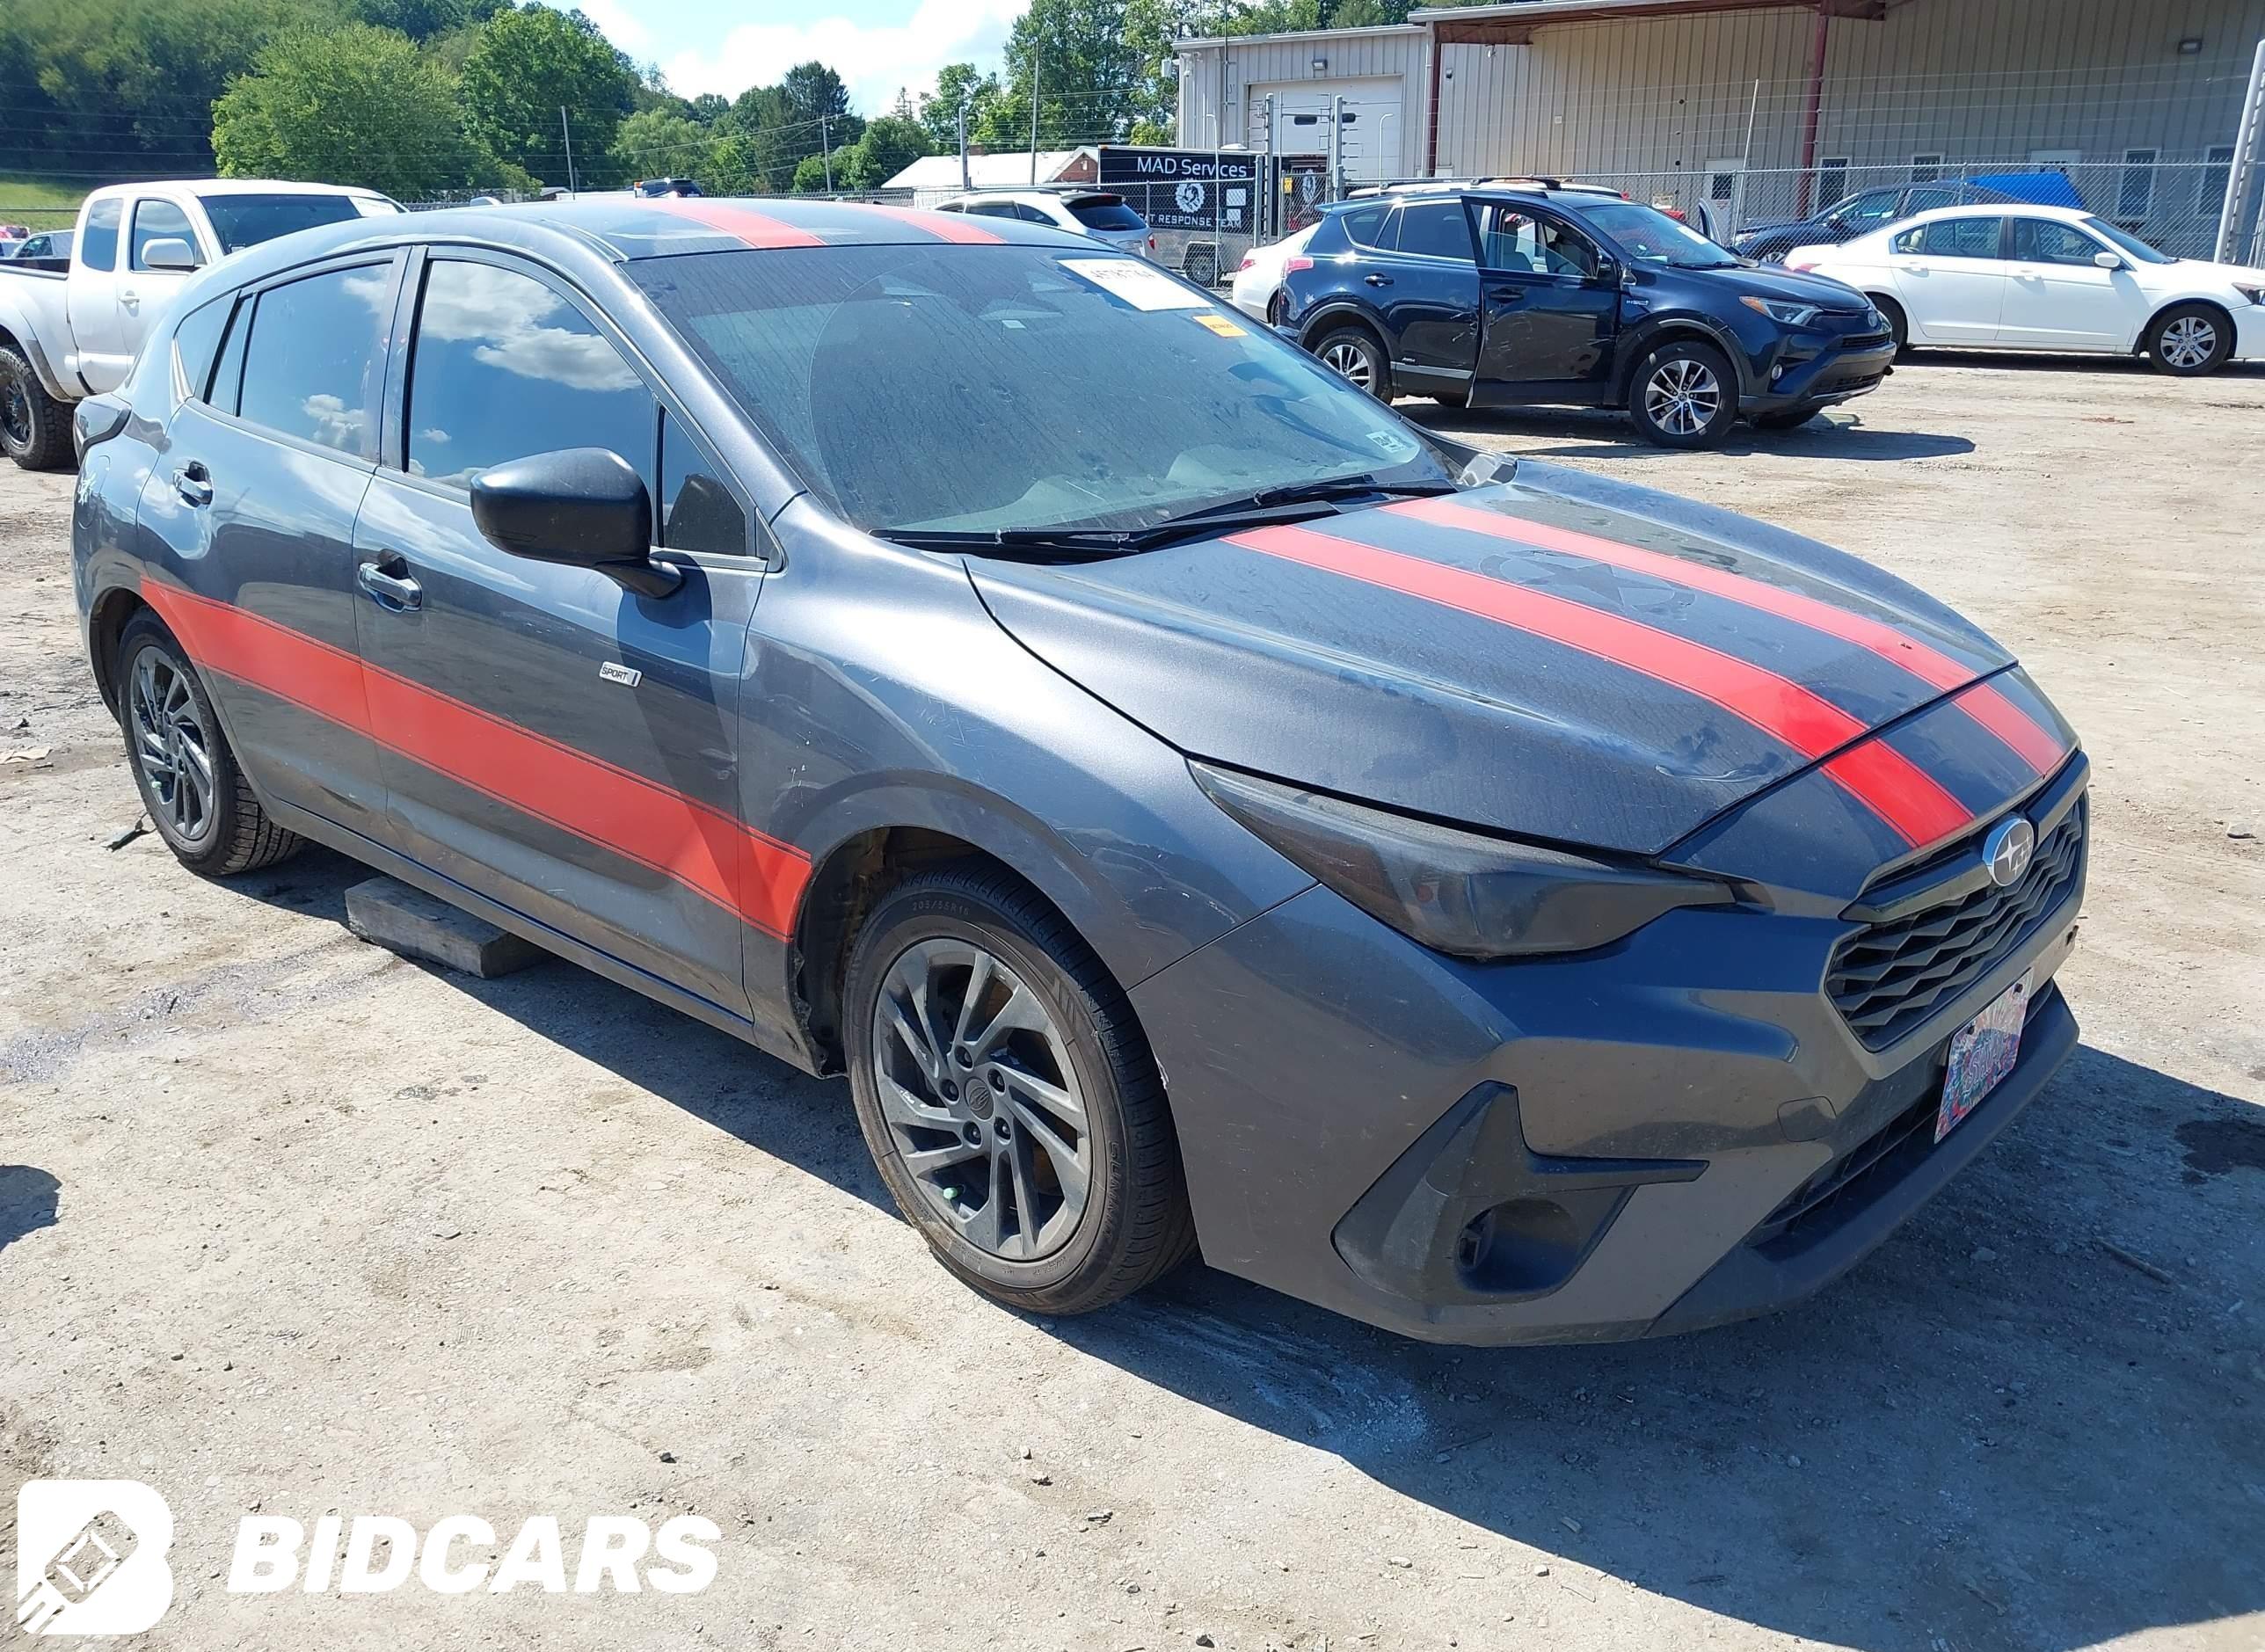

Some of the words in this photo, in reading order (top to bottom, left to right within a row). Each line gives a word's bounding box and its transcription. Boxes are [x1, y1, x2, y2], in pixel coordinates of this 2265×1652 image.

[1137, 156, 1176, 174] MAD
[1181, 159, 1247, 177] Servces
[1158, 214, 1212, 227] RESPONSE
[601, 666, 628, 680] SPORT
